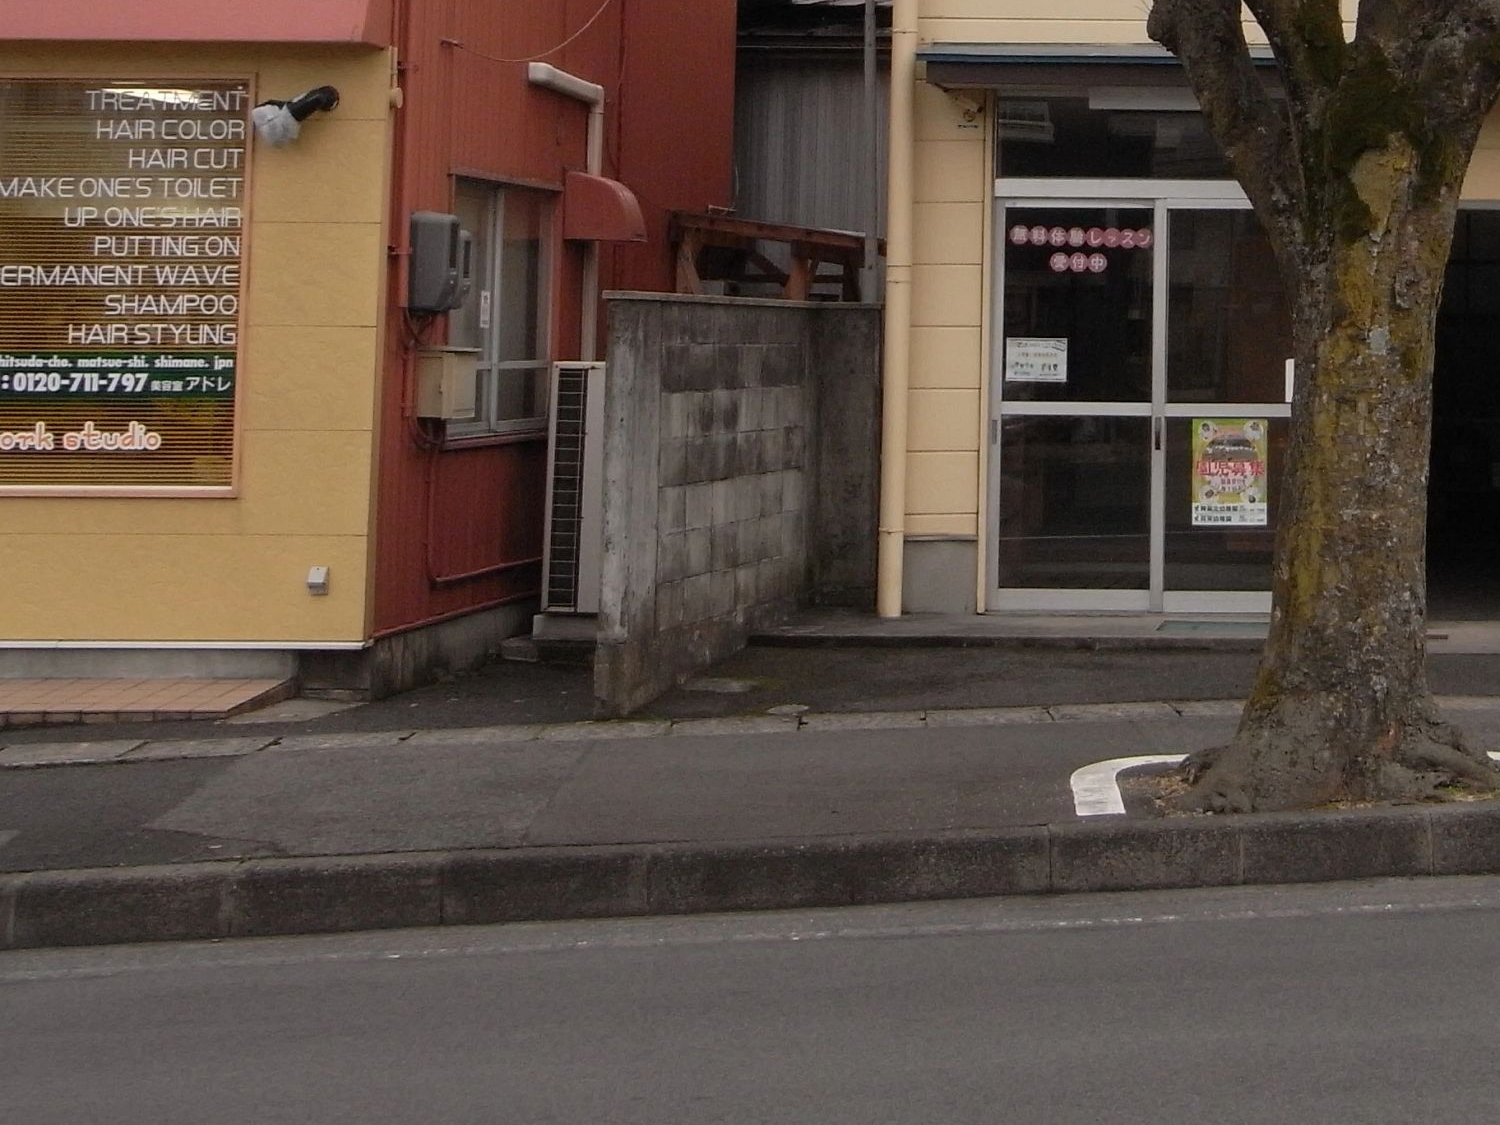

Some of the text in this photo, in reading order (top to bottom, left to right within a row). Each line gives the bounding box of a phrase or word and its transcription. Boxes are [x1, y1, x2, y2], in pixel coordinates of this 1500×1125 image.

[85, 90, 246, 111] TREATMENT
[96, 119, 245, 140] HAIR COLOR
[129, 148, 244, 169] HAIR CUT
[0, 177, 243, 198] MAKE ONE'S TOILET
[64, 207, 241, 228] UP ONE'S HAIR
[94, 236, 240, 256] PUTTING ON
[155, 265, 239, 286] WAVE
[105, 294, 237, 315] SHAMPOO
[68, 324, 237, 344] HAIR STYLING
[214, 355, 234, 370] jpn
[63, 421, 161, 450] studio
